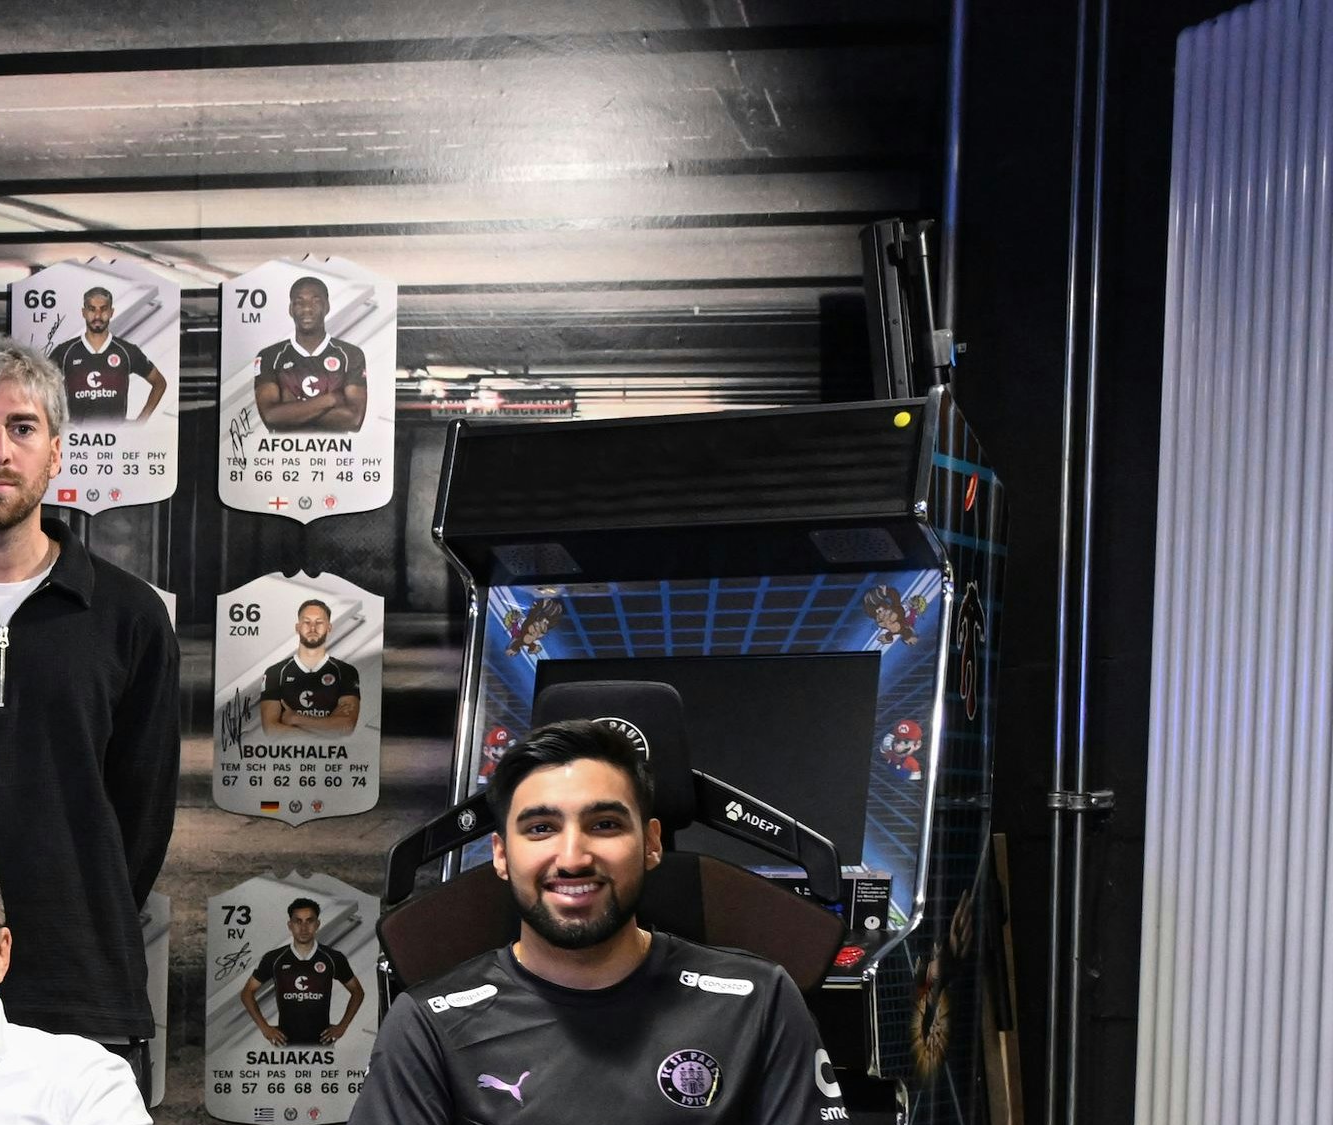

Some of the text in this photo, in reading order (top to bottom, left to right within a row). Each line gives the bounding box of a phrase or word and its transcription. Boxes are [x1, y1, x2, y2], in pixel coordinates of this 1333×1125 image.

[24, 289, 56, 309] 66
[235, 289, 267, 309] 70
[33, 312, 48, 323] LF
[241, 312, 261, 323] LM
[75, 388, 118, 400] congstar
[68, 433, 117, 447] SAAD
[257, 438, 352, 452] AFOLAYAN
[69, 451, 167, 461] PAS DRI DEF PHY
[253, 457, 274, 466] SCH
[282, 457, 300, 466] PAS
[309, 457, 326, 466] DRI
[336, 457, 355, 466] DEF
[362, 457, 382, 466] PHY
[69, 464, 165, 476] 60 70 33 53
[229, 471, 381, 482] 81 66 62 71 48 69
[228, 603, 261, 623] 66
[229, 625, 259, 637] ZOM
[244, 745, 348, 759] BOUKHALFA
[221, 763, 368, 772] TEM SCH PAS DRI DEF PHY
[222, 776, 367, 787] 67 61 62 66 60 74
[742, 809, 782, 836] ADEPT
[221, 905, 251, 925] 73
[227, 928, 246, 940] RV
[283, 990, 323, 1001] congstar
[246, 1051, 334, 1065] SALIAKAS
[212, 1070, 366, 1079] TEM SCH PAS DRI DEF PHY
[661, 1066, 673, 1078] FC
[214, 1083, 232, 1094] 68
[241, 1083, 258, 1094] 57
[267, 1083, 285, 1094] 66
[294, 1083, 312, 1094] 68
[321, 1083, 339, 1094] 66
[681, 1095, 707, 1105] 1910
